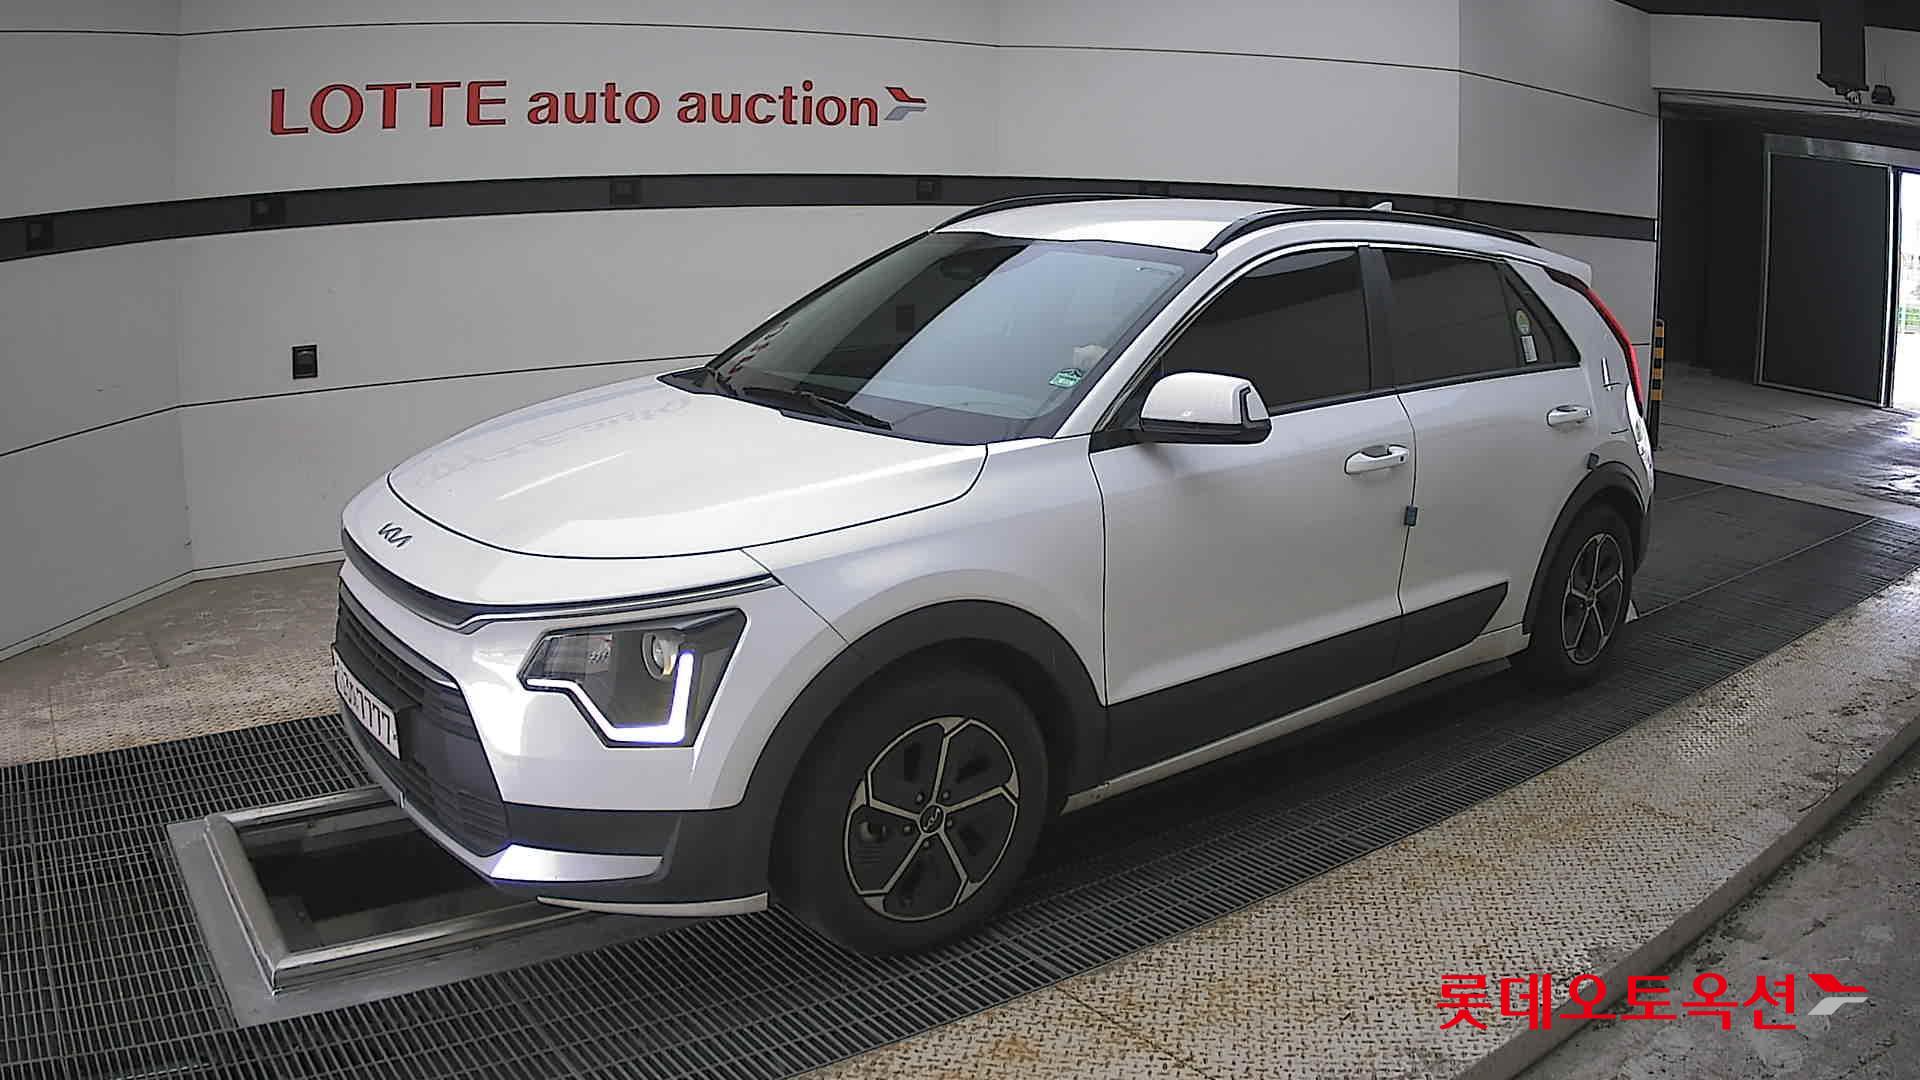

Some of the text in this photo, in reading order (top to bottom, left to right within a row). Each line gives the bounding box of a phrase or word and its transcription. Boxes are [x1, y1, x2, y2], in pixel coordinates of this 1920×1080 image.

[269, 80, 878, 136] LOTTE auto auction
